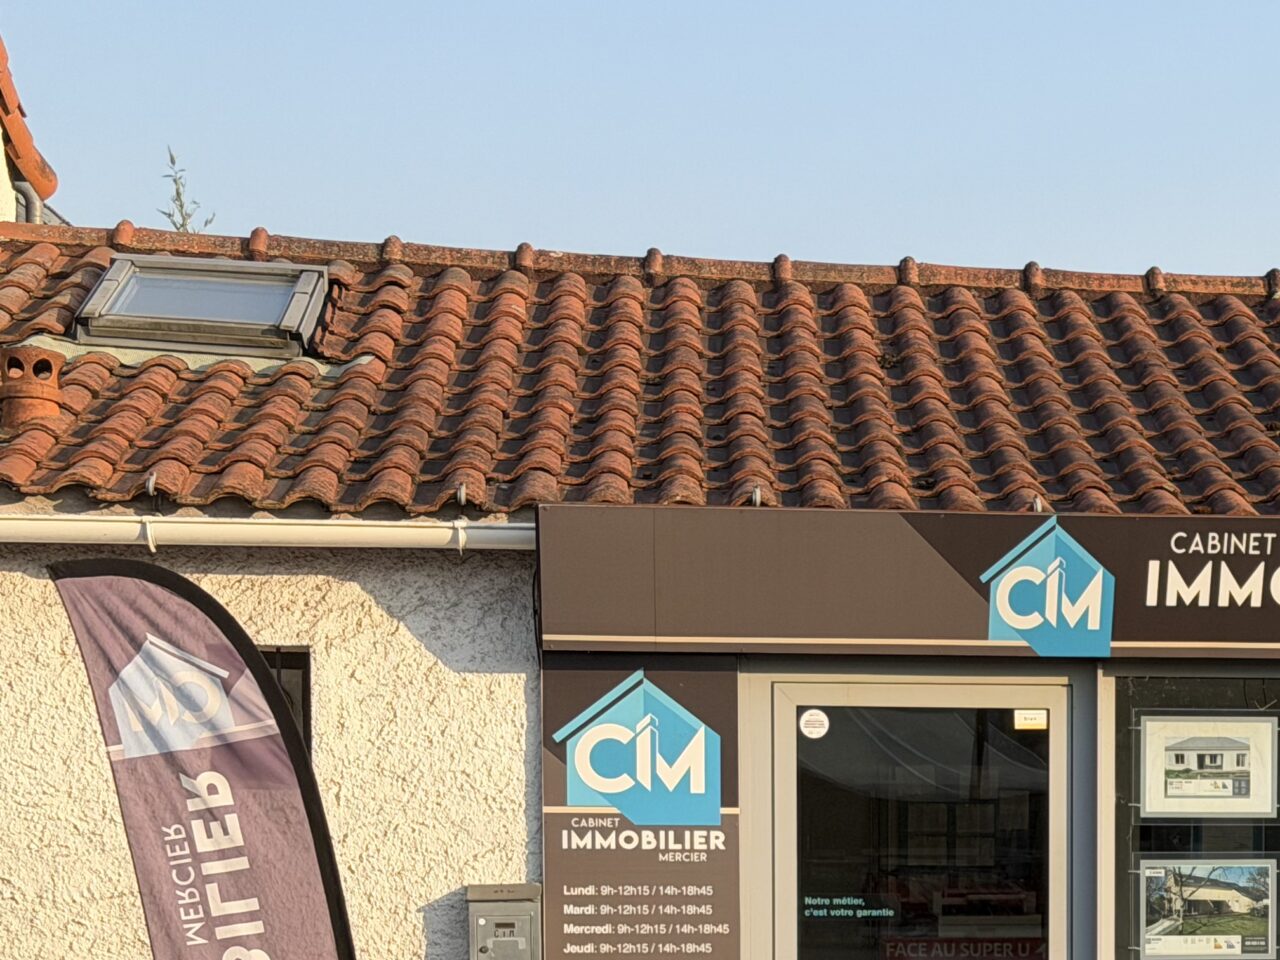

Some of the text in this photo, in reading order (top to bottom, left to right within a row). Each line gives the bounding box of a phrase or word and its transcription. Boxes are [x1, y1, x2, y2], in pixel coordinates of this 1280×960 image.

[1170, 532, 1277, 555] CABINET
[571, 817, 620, 828] CABINET
[562, 829, 726, 850] IMMOBILIER
[658, 852, 708, 862] MERCIER
[563, 885, 598, 896] Lundi:
[600, 885, 650, 896] 9h-12h15
[659, 885, 713, 896] 14h-18h45
[804, 896, 830, 906] Notre
[563, 904, 598, 915] Mardi:
[600, 904, 649, 915] 9h-12h15
[658, 904, 712, 915] 14h-18h45
[804, 908, 895, 918] c'est votre garantie
[563, 923, 615, 934] Mercredi:
[617, 923, 666, 934] 9h-12h15
[675, 923, 730, 934] 14h-18h45
[563, 943, 598, 953] Jeudi:
[599, 943, 649, 953] 9h-12h15
[658, 943, 712, 953] 14h-18h45
[886, 942, 1031, 958] FACE AU SUPER U
